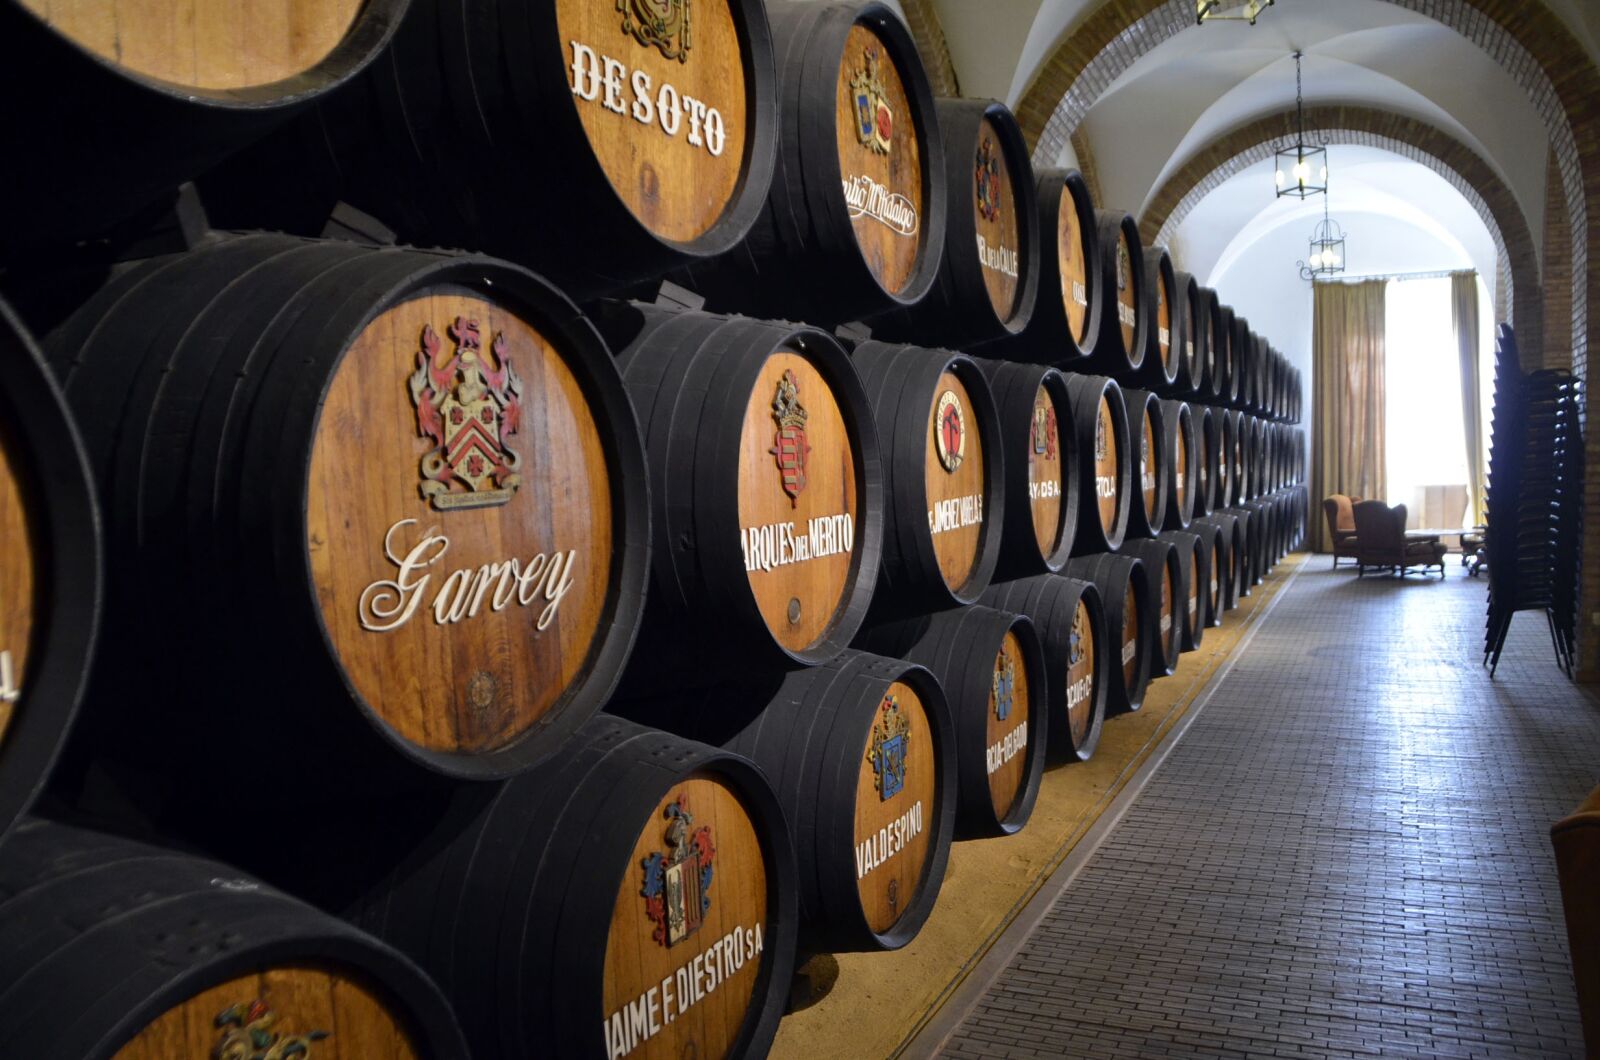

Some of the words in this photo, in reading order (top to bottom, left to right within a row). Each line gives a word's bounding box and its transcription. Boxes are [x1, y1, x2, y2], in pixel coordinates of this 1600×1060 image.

[359, 518, 576, 632] Garvey
[808, 513, 853, 558] MERITO
[855, 800, 922, 880] VALDESPINO
[676, 926, 744, 1015] DIESTRO
